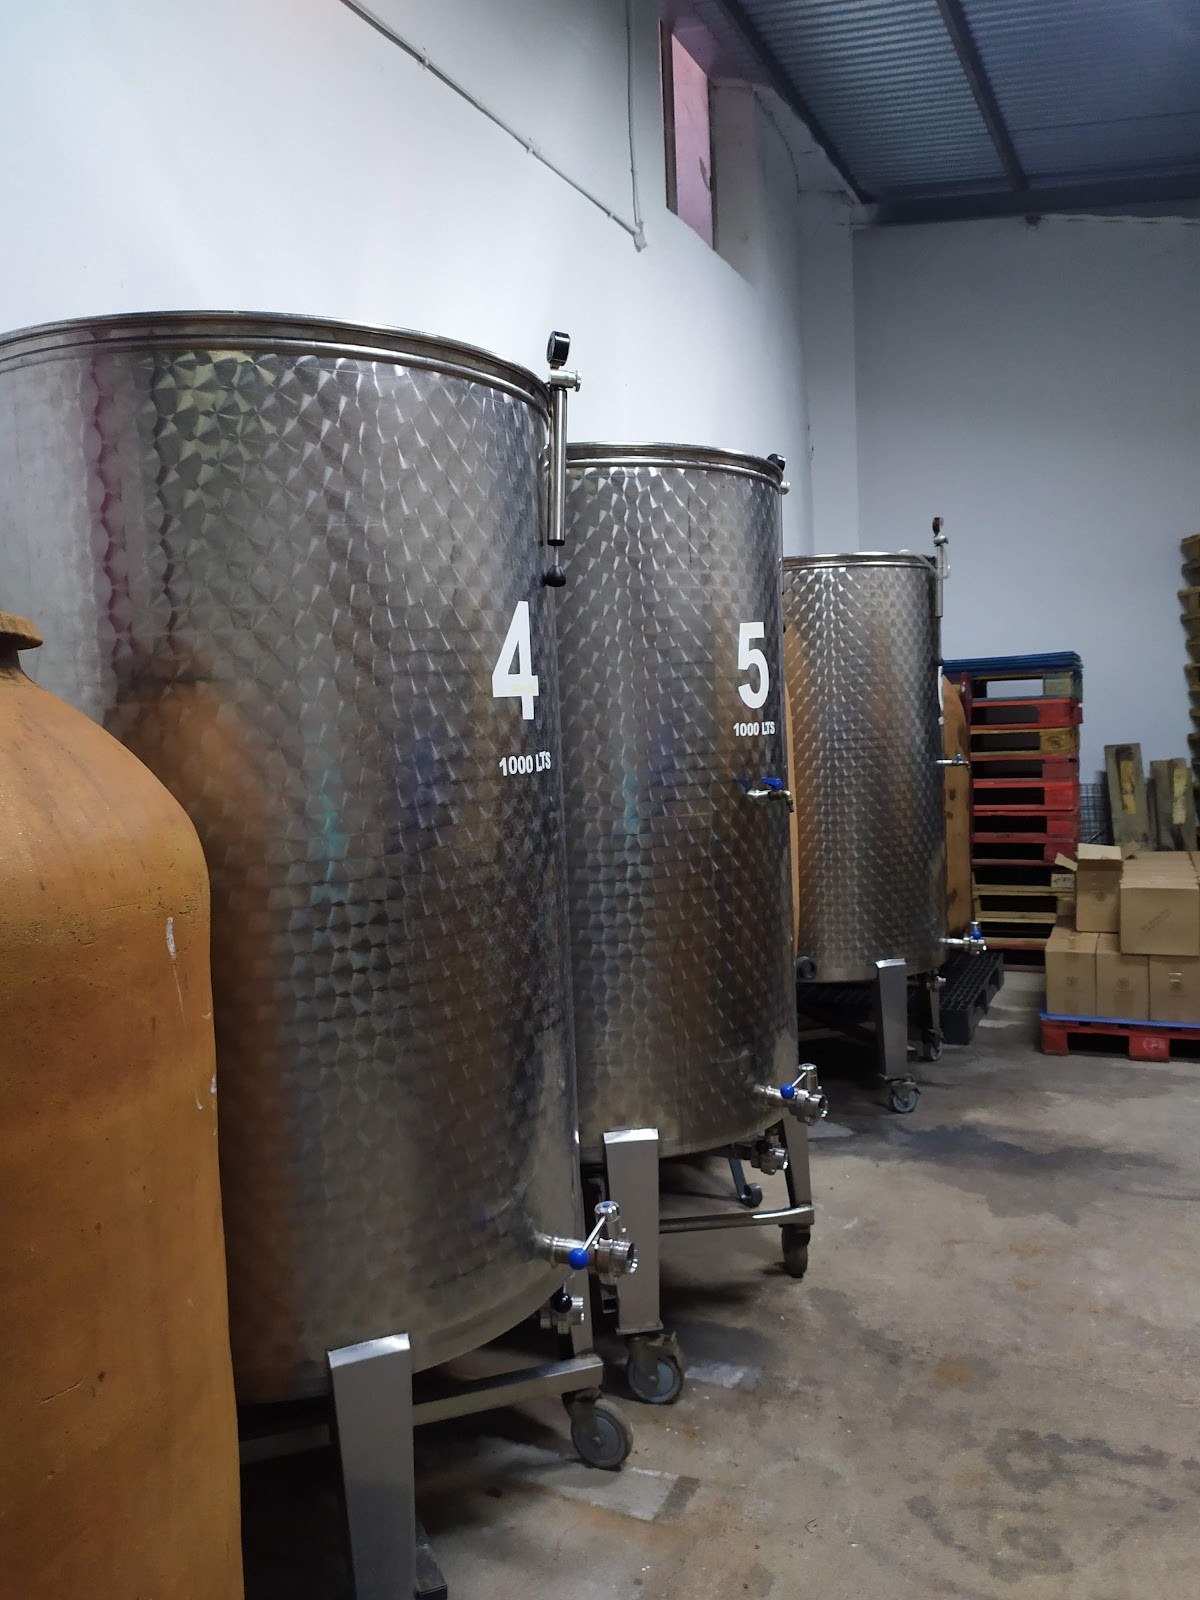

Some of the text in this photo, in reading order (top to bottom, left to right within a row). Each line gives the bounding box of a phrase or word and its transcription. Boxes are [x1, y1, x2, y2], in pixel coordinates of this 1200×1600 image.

[492, 600, 539, 720] 4
[738, 621, 770, 709] 5
[733, 721, 776, 737] 1000 LTS
[498, 750, 552, 777] 1000 LTS
